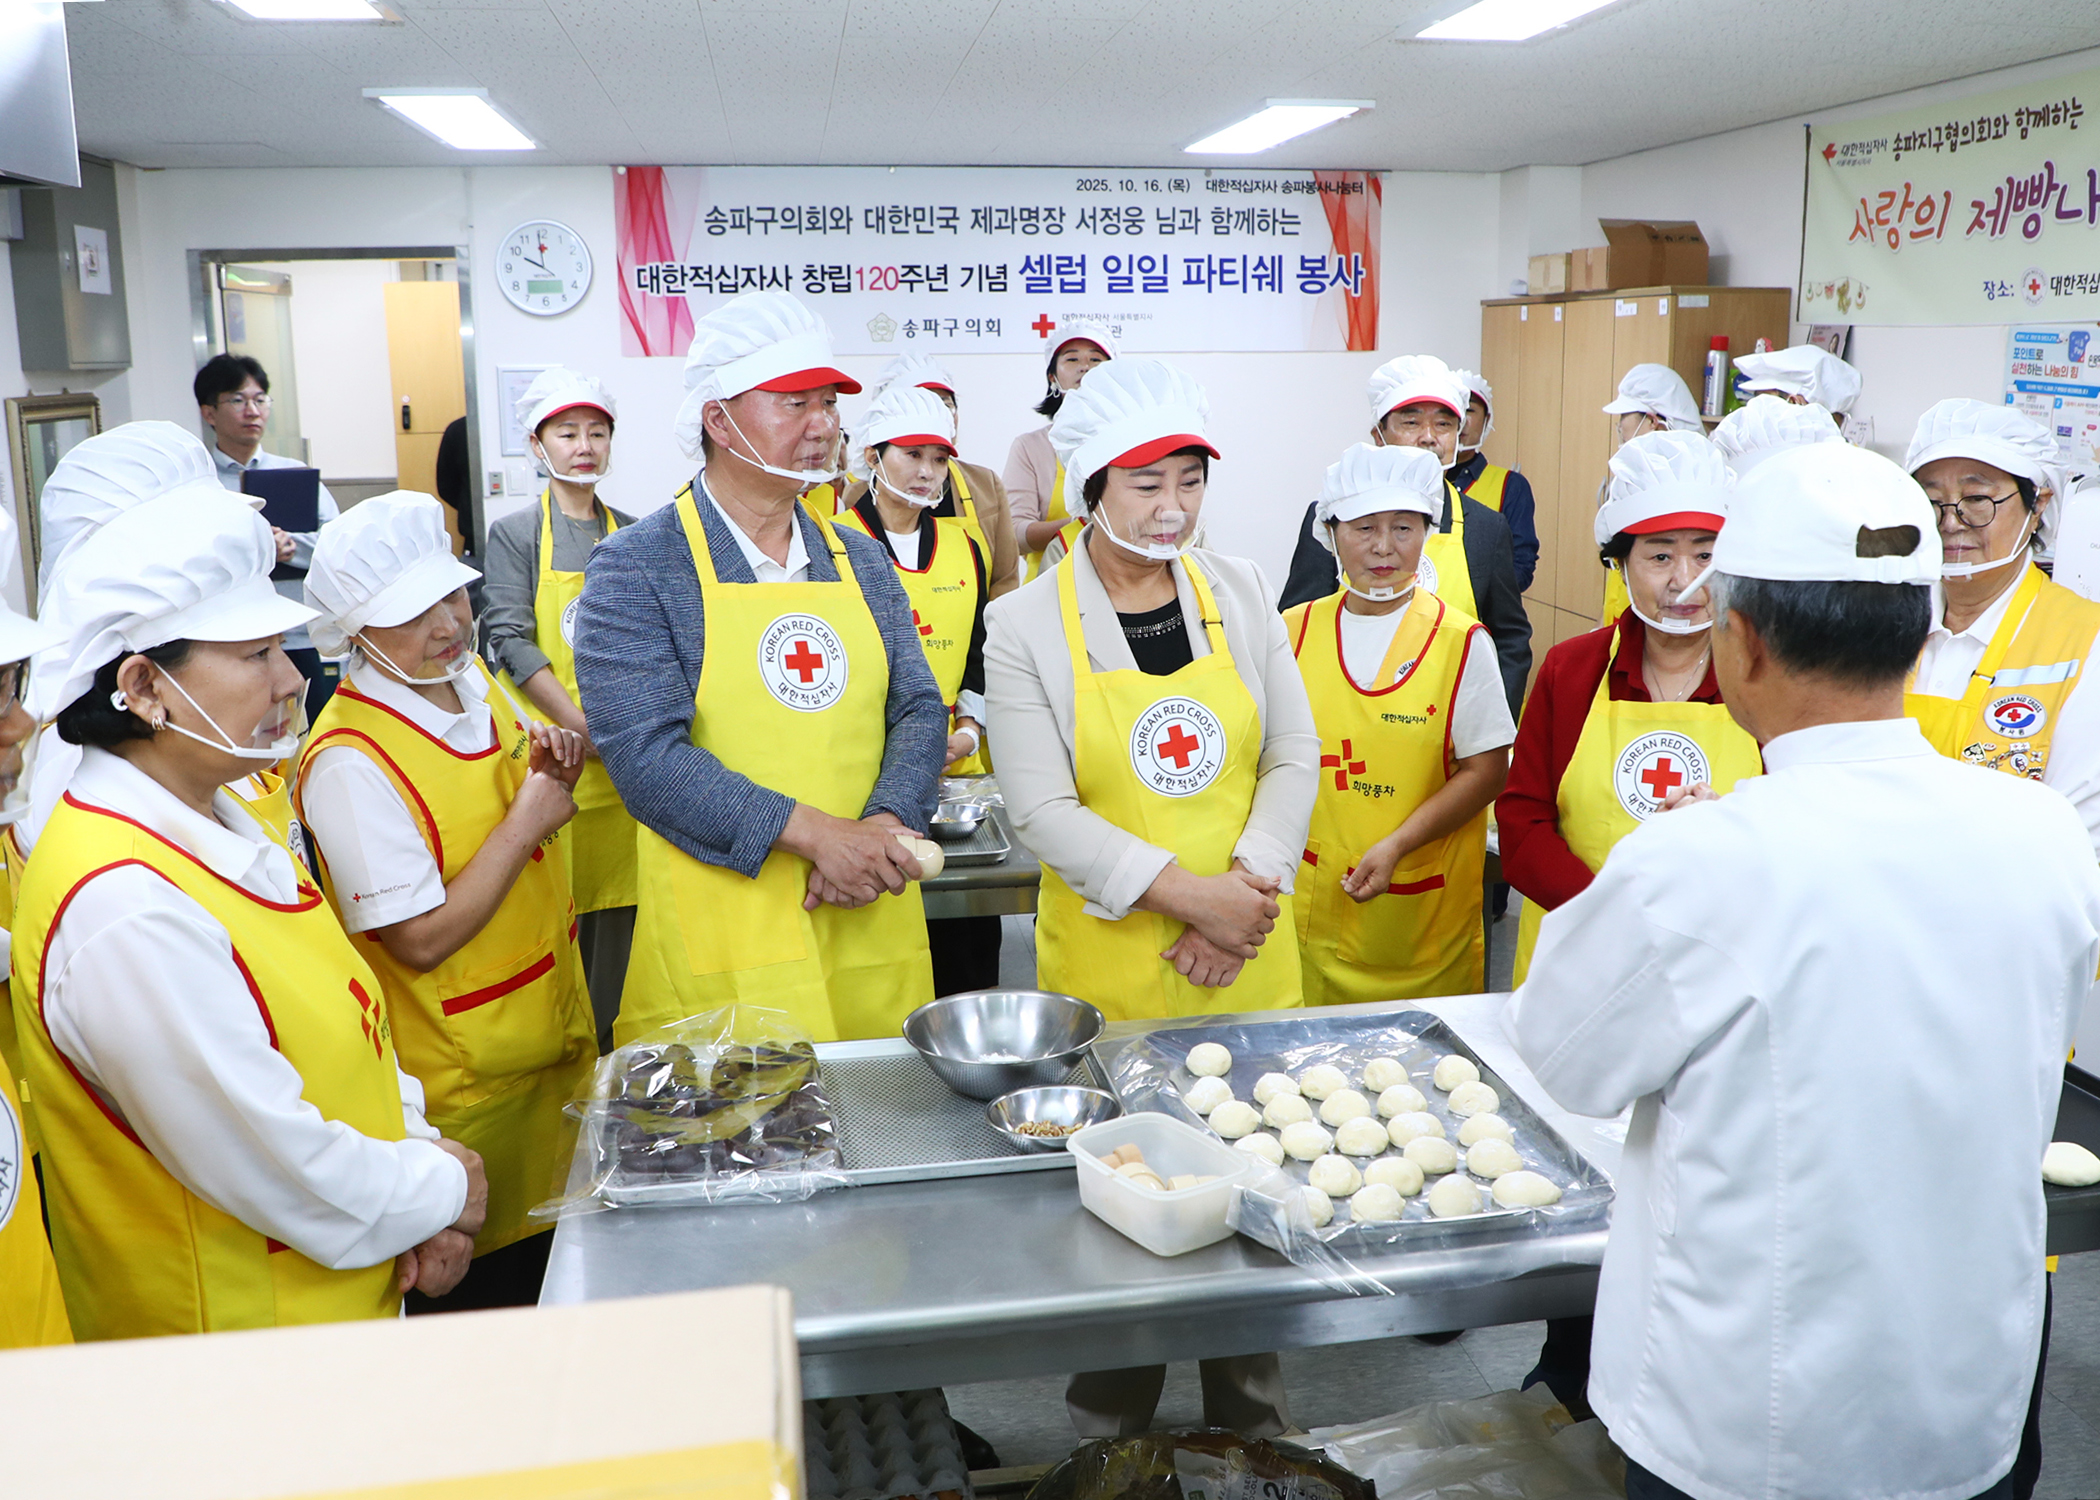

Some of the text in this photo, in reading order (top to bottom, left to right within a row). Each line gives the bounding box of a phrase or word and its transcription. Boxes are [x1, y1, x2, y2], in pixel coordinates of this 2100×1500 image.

[1893, 97, 2084, 161] 송파지구협의회와 함께하는
[1841, 138, 1888, 157] 대한적십자사
[1076, 178, 1363, 195] 2025. 10. 16. (목) 대한적십자사 송파봉사나눔터
[704, 205, 1301, 236] 송파구의회와 대한민국 제과명장 서정웅 님과 함께하는
[1848, 182, 1952, 250] 사랑의
[520, 235, 529, 244] 11
[558, 235, 563, 244] 1
[510, 246, 522, 256] 10
[570, 245, 577, 256] 2
[505, 263, 513, 273] 9
[576, 261, 583, 272] 3
[636, 254, 1364, 295] 대한적십자사 창립120주년 기념 셀럽 일일 파티쉐 봉사
[512, 280, 520, 291] 8
[571, 280, 578, 289] 4
[1983, 280, 2014, 300] 장소:
[525, 294, 530, 302] 7
[542, 296, 550, 307] 6
[561, 294, 567, 302] 5
[902, 317, 1002, 339] 송파구의회
[2013, 347, 2044, 361] 포인트로
[2011, 362, 2079, 379] 실천하는 나눔의 힘
[765, 620, 840, 663] KOREAN RED CROSS
[778, 681, 838, 705] 대한적십자사
[1381, 713, 1427, 725] 대한적십자사
[1137, 704, 1217, 756] KOREAN RED CROSS
[1622, 737, 1703, 781] KOREAN RED CROSS
[1153, 760, 1216, 790] 대한적십자사
[1352, 780, 1395, 799] 희망풍차
[380, 887, 393, 895] Red
[393, 883, 411, 892] Cross
